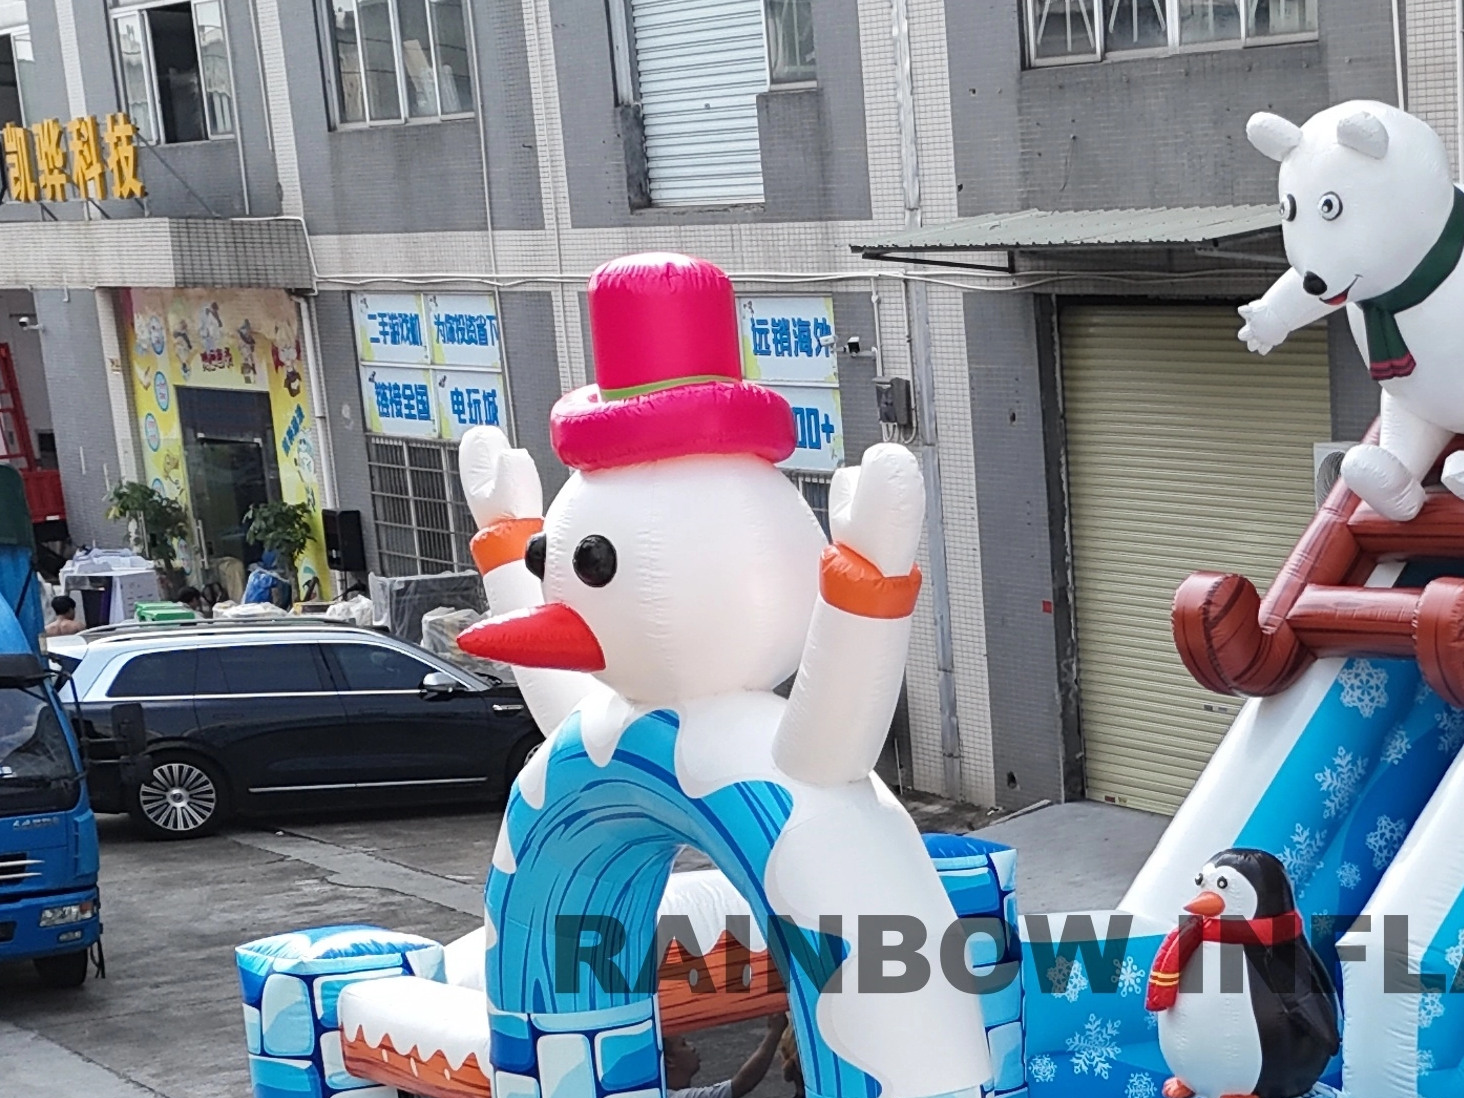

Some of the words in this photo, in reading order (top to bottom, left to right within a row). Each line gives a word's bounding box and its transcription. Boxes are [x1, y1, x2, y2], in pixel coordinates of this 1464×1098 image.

[3, 112, 147, 202] 凯骅科技
[367, 312, 423, 346] 二手游戏机
[751, 317, 832, 358] 远销海外
[450, 387, 499, 426] 电玩城
